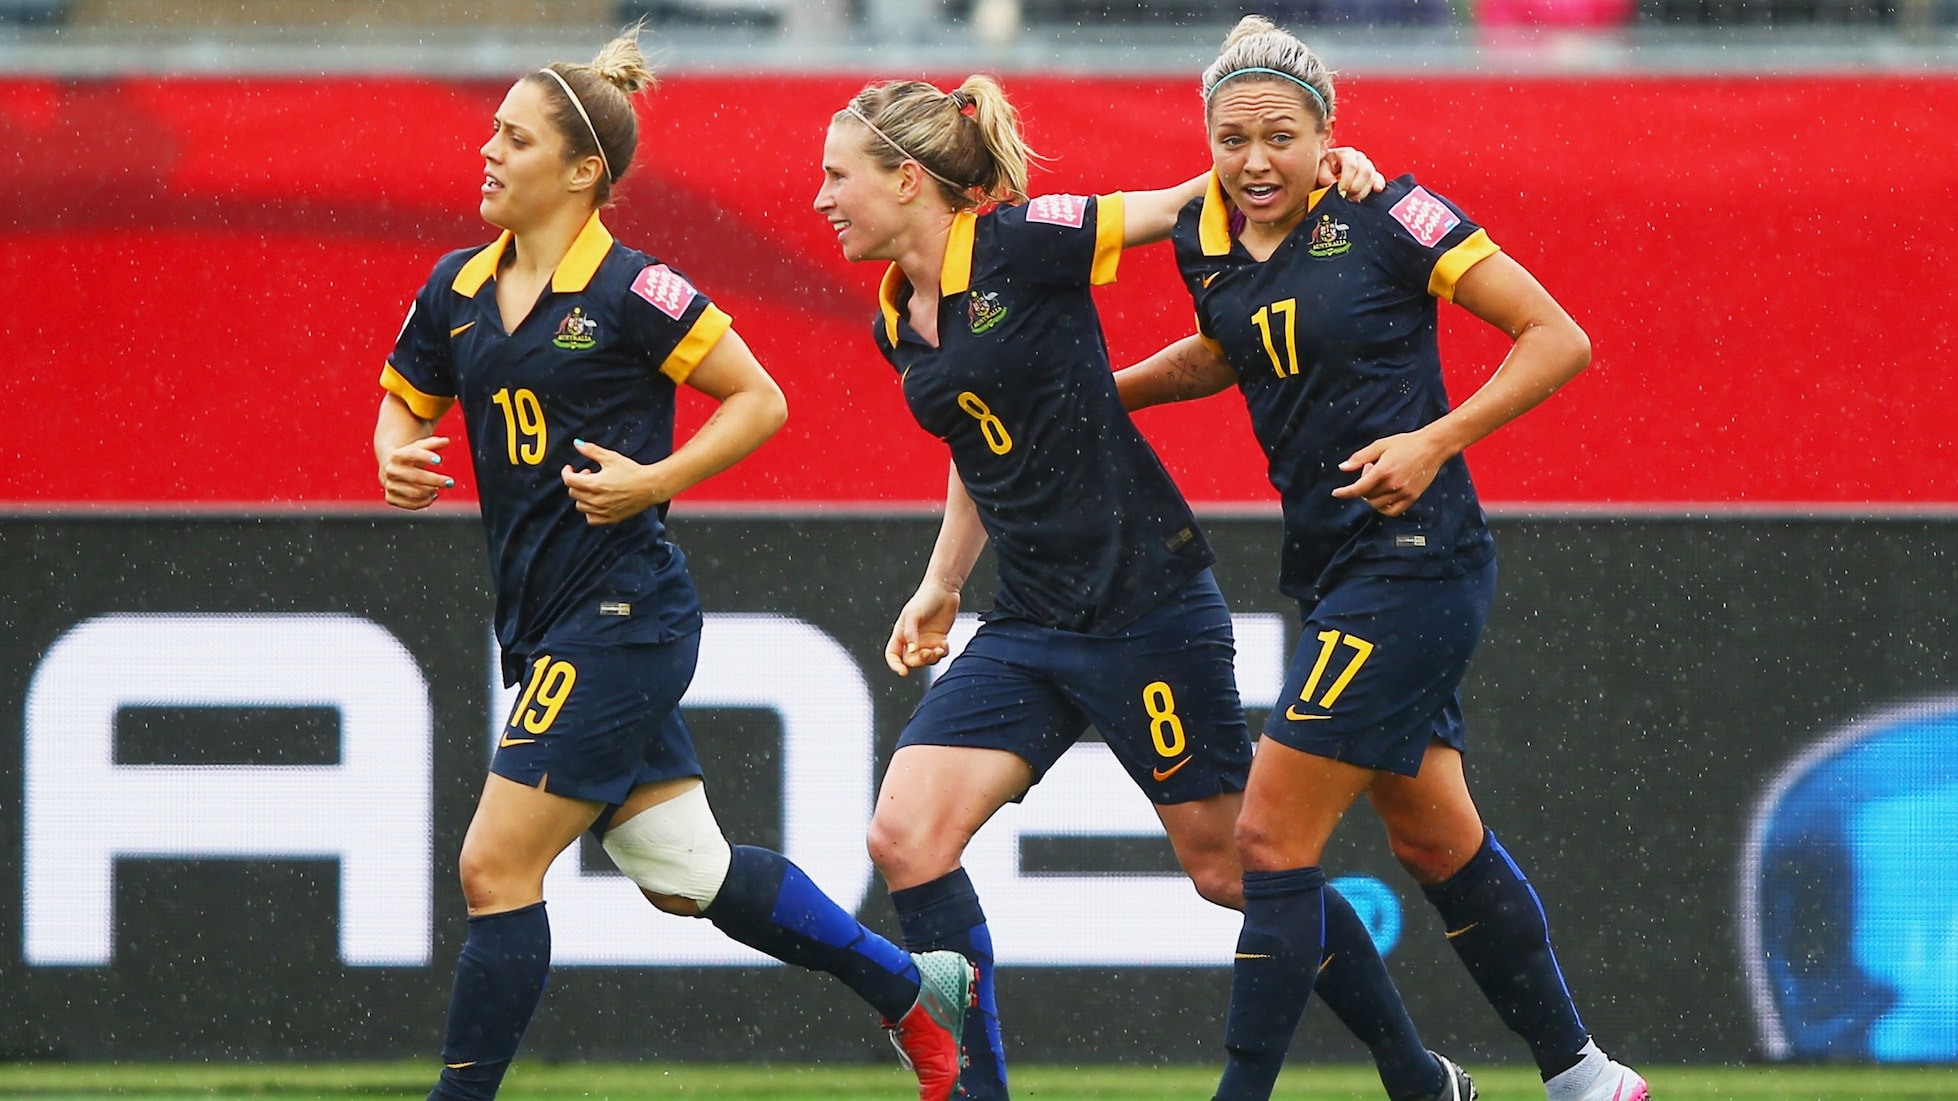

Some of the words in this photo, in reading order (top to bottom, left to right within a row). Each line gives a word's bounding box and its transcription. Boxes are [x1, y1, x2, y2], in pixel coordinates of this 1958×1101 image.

[1402, 196, 1422, 224] LIVE
[1411, 200, 1434, 232] YOUR
[1420, 203, 1446, 241] GOALS
[644, 268, 660, 298] LIVE
[1250, 298, 1300, 379] 17
[491, 387, 547, 466] 19
[957, 391, 1013, 456] 8
[508, 655, 577, 735] 19
[1298, 629, 1375, 713] 17
[1142, 680, 1186, 758] 8
